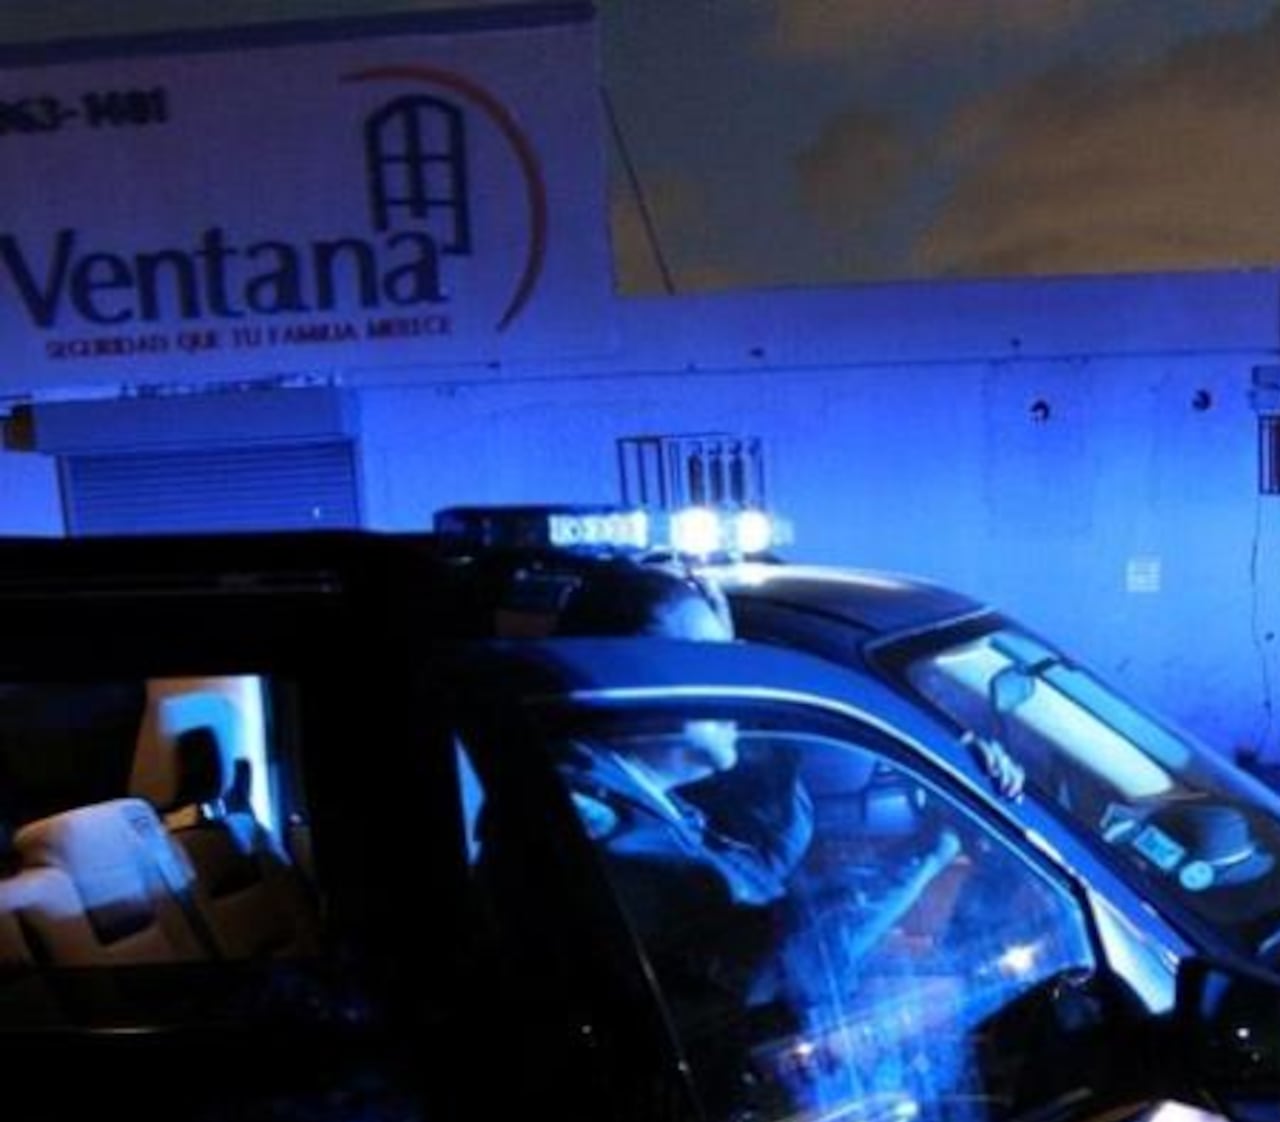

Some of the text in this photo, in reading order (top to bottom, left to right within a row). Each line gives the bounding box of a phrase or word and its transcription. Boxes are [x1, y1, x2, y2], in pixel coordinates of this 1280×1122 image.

[2, 227, 448, 330] Ventana
[177, 329, 219, 353] QUE
[232, 326, 262, 349] TU
[268, 322, 357, 346] FAMILIA
